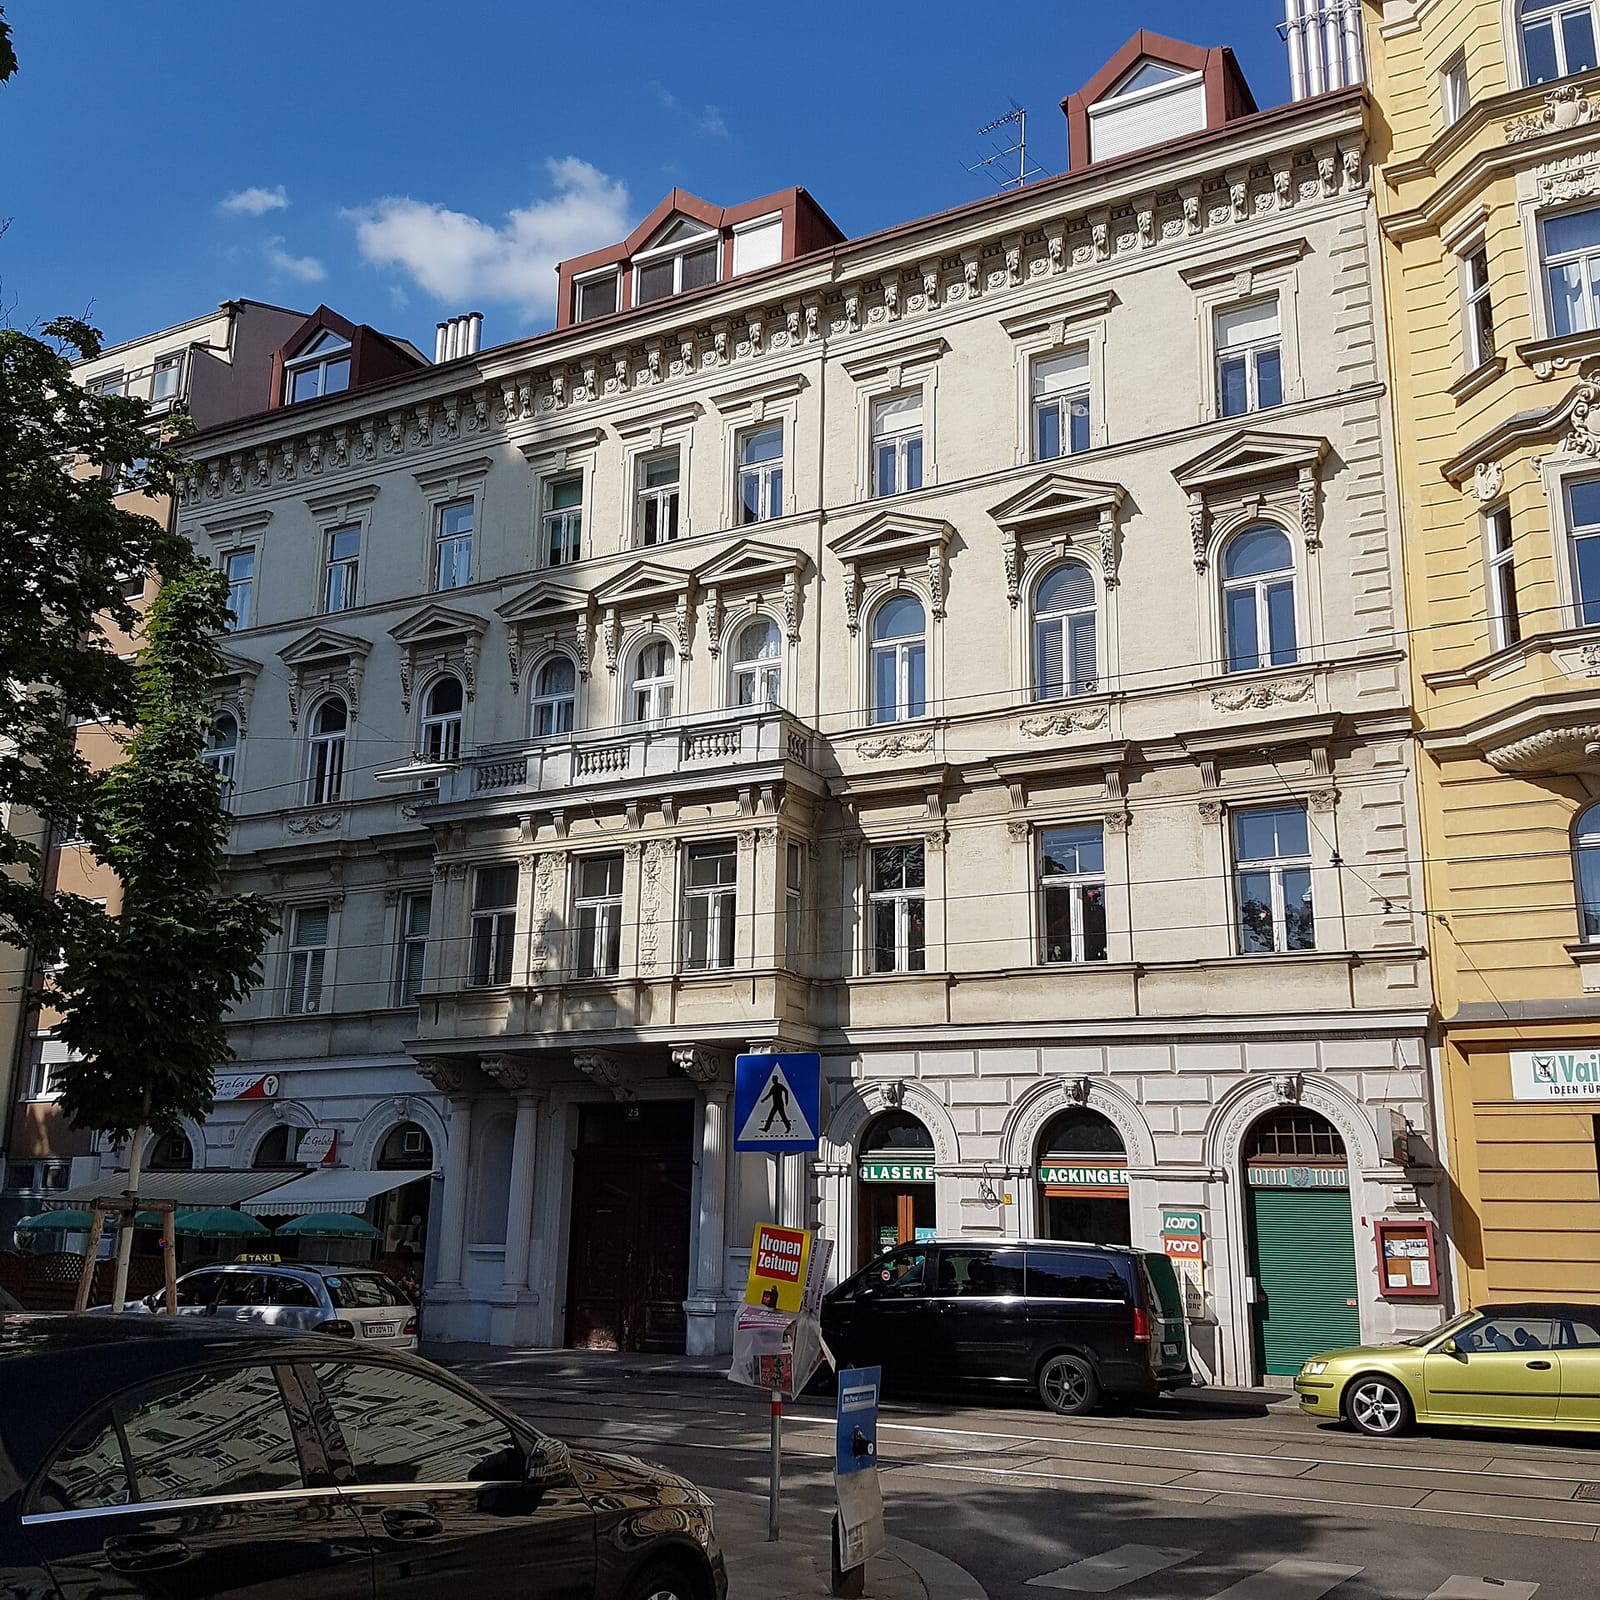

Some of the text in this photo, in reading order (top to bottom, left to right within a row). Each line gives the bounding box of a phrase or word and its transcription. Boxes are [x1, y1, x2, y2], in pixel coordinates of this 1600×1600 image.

[1558, 1053, 1600, 1083] Vai
[1549, 1085, 1579, 1095] IDEEN
[859, 1166, 934, 1180] GLASERE
[1038, 1168, 1129, 1184] LACKINGER
[1247, 1167, 1346, 1186] LOTTO TOTO
[1165, 1217, 1198, 1230] LOTTO
[760, 1233, 801, 1256] Kronen
[1165, 1239, 1200, 1254] TOTO
[248, 1254, 273, 1262] TAXI
[758, 1252, 799, 1276] Zeitung
